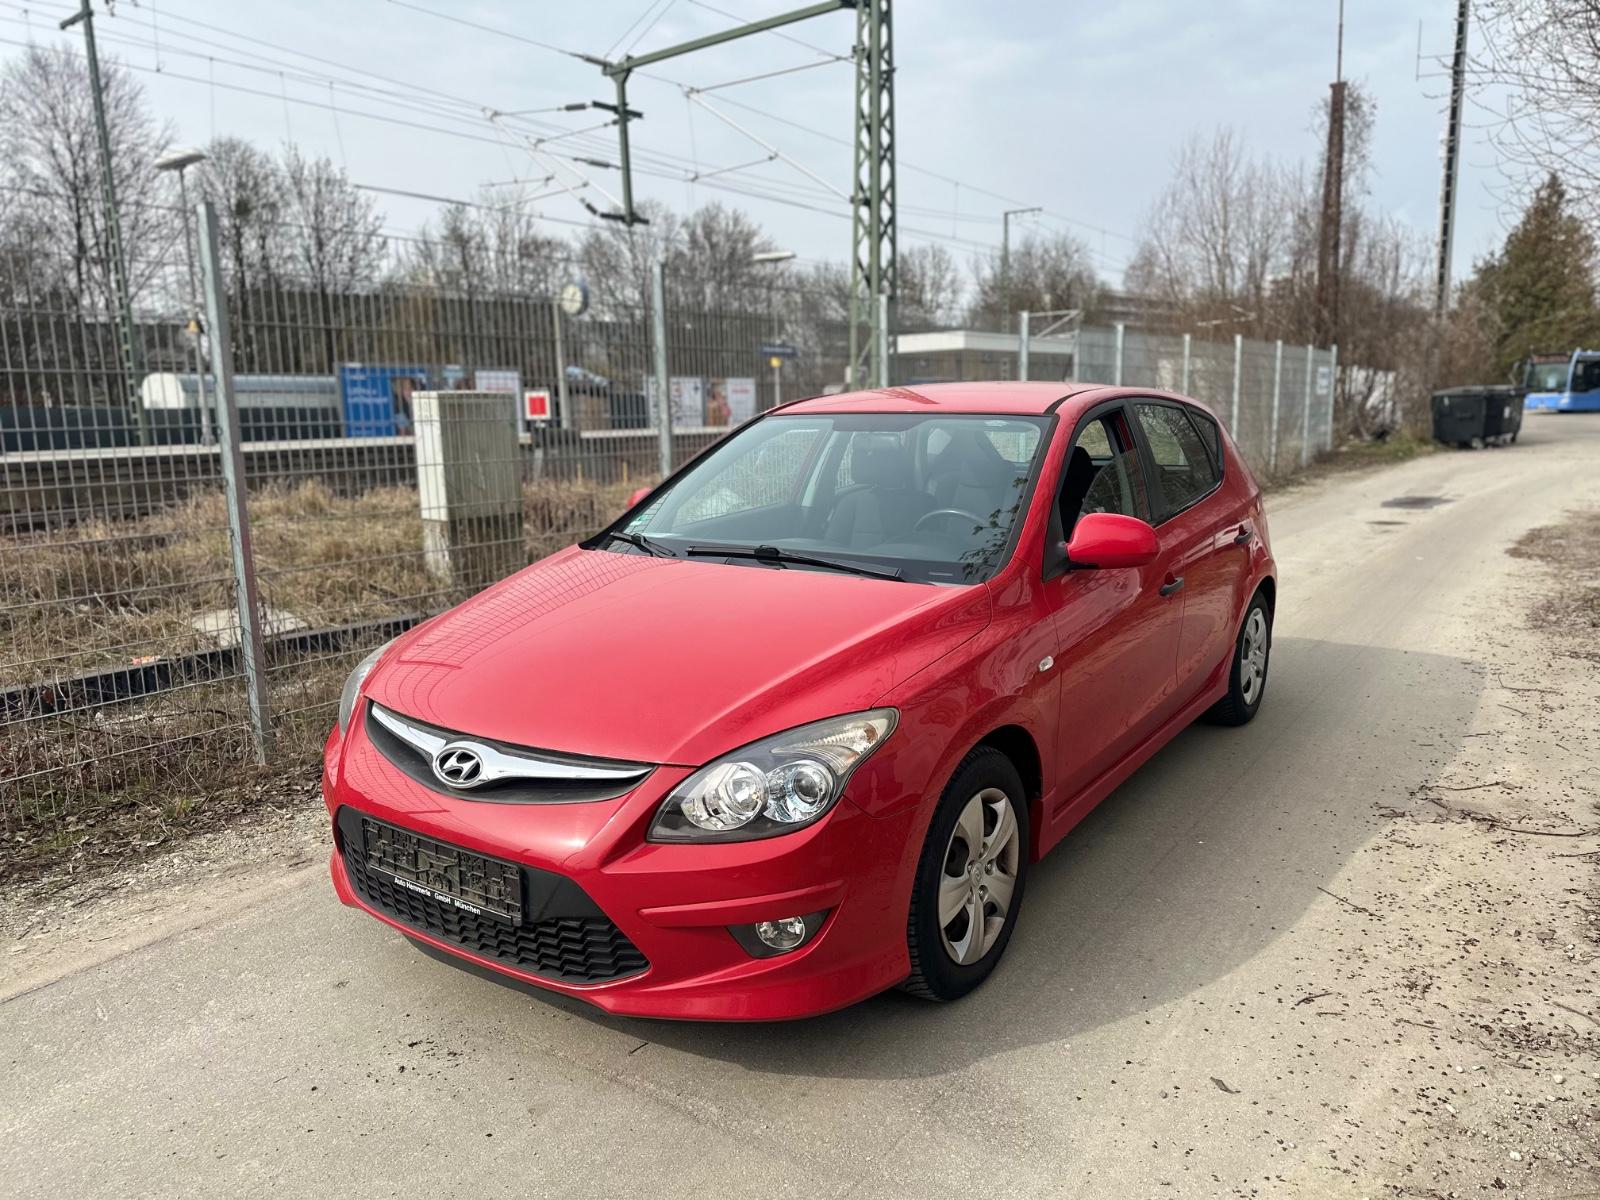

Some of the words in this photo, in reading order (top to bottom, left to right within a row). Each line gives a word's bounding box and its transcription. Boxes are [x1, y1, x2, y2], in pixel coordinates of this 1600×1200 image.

[395, 877, 406, 887] Auto
[434, 893, 451, 904] GmbH
[454, 900, 481, 915] München
